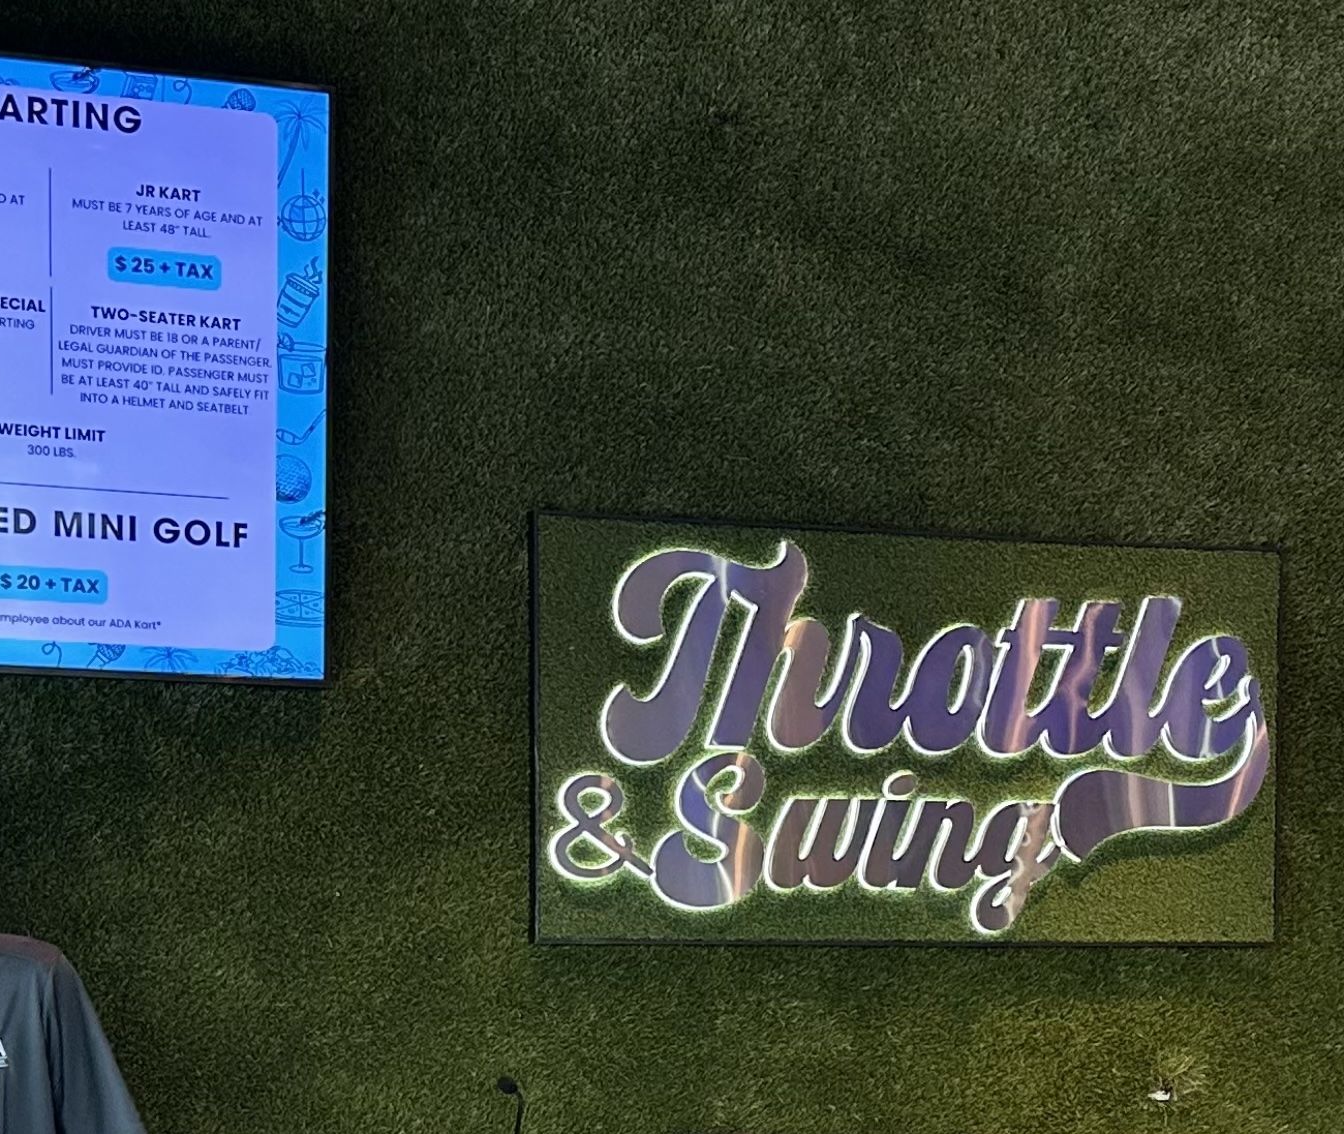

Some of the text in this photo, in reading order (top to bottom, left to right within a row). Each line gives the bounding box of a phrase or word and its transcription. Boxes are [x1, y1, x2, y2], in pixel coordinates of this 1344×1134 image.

[136, 184, 200, 202] JR KART
[115, 255, 212, 279] $ 25 + TAX
[91, 306, 240, 330] TWO-SEATER KART
[65, 427, 105, 442] LIMIT
[27, 444, 50, 456] 300
[54, 510, 136, 541] MINI
[153, 517, 247, 548] GOLF
[600, 541, 1264, 764] Throttle
